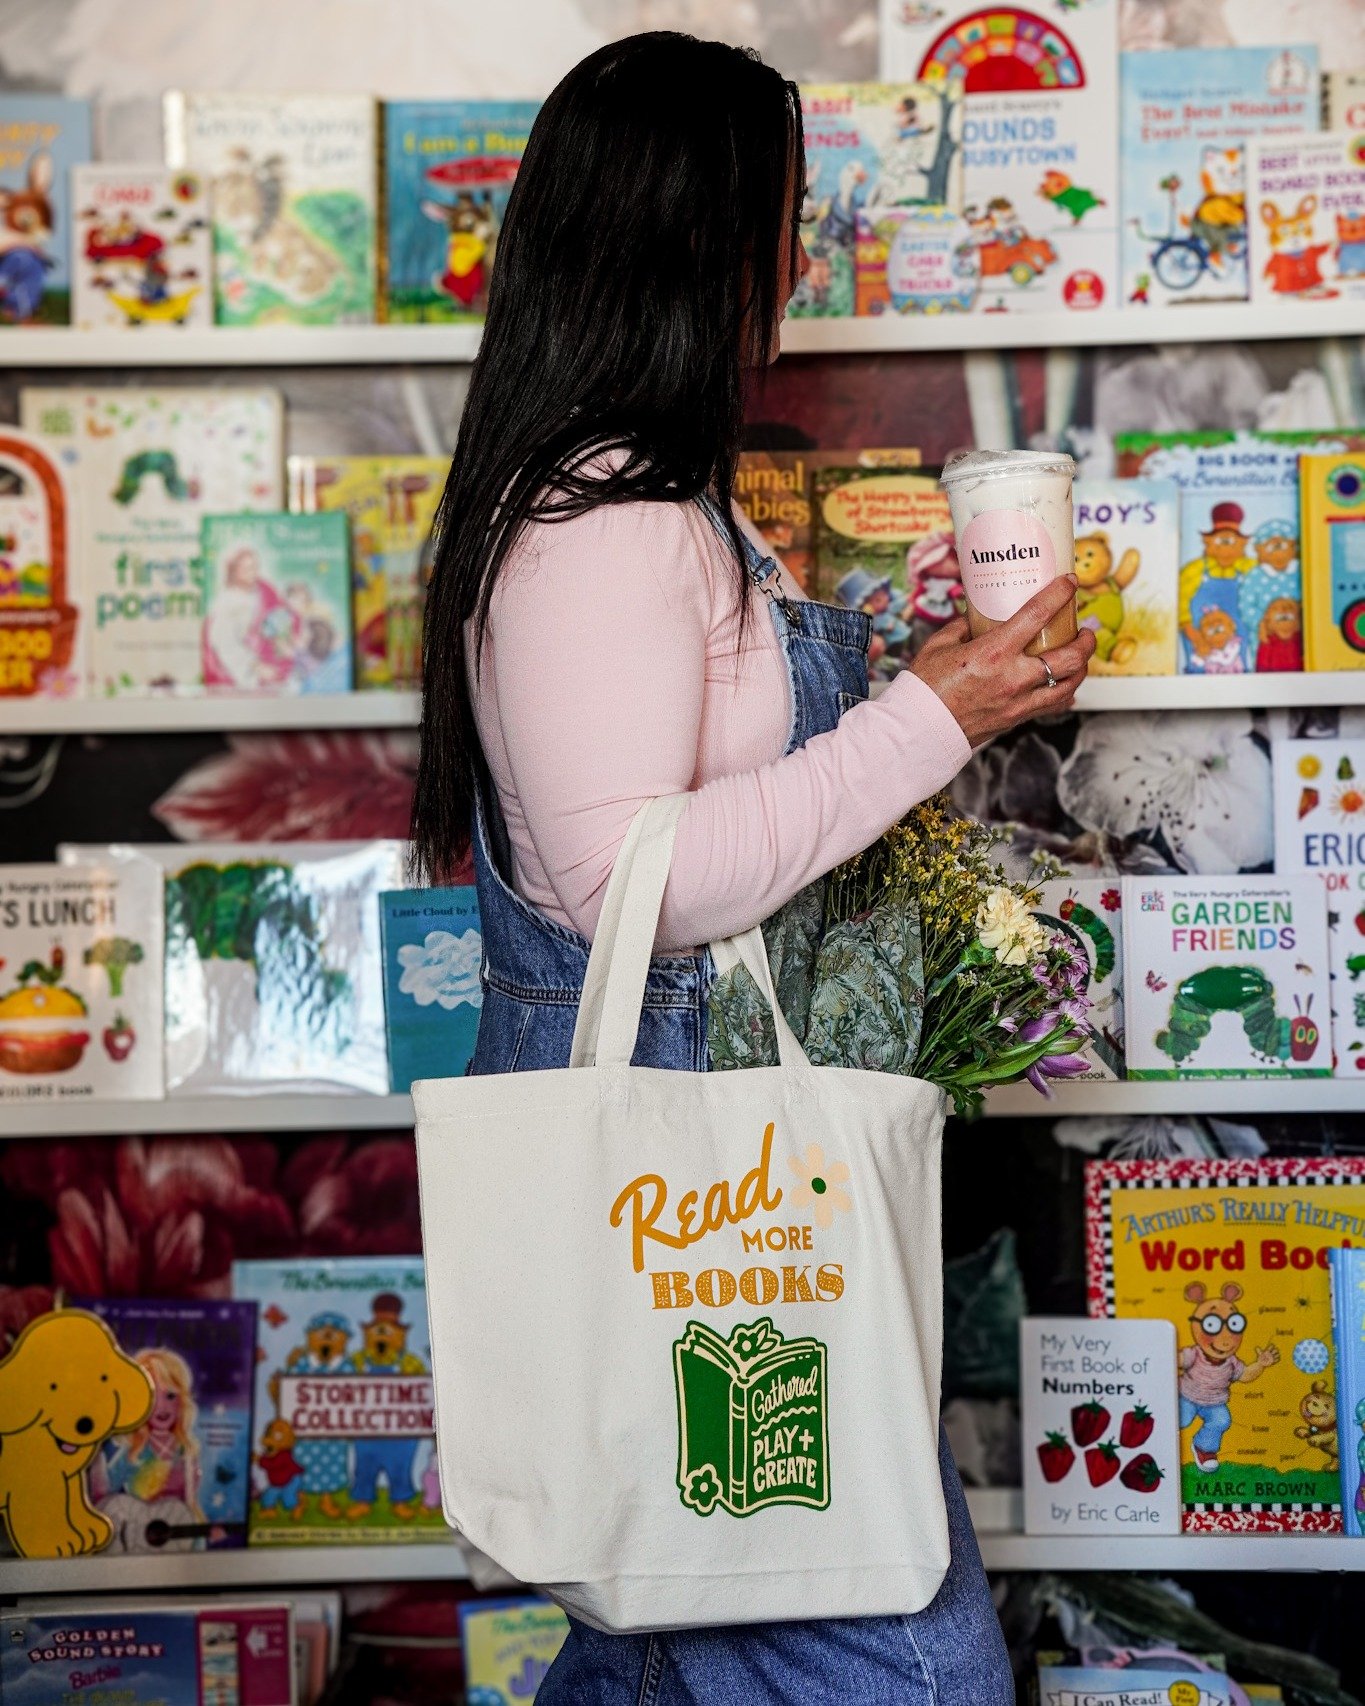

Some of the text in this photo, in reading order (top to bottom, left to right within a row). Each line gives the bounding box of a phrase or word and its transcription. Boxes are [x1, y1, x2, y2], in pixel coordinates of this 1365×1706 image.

[969, 543, 1040, 564] Amsden
[974, 578, 1038, 589] COFFEE CLUB
[28, 898, 115, 927] LUNCH
[392, 907, 420, 918] Little
[422, 907, 453, 917] Cloud
[456, 906, 468, 917] by
[1171, 900, 1293, 926] GARDEN
[1172, 926, 1296, 952] FRIENDS
[609, 1122, 783, 1274] Read
[1121, 1197, 1365, 1243] ARTHUR'S REALLY HELPFU
[740, 1226, 813, 1253] MORE
[1140, 1239, 1245, 1271] Word
[648, 1263, 844, 1310] BOOKS
[1041, 1334, 1112, 1356] My Very
[1041, 1355, 1150, 1375] First Book of
[296, 1381, 430, 1405] STORYTIME
[751, 1366, 818, 1423] Gathered
[1042, 1377, 1135, 1396] Numbers
[292, 1408, 434, 1431] COLLECTION
[753, 1456, 816, 1489] CREATE
[1195, 1481, 1317, 1497] MARC BROWN
[1051, 1505, 1160, 1524] by Eric Carle
[53, 1628, 136, 1644] GOLDEN
[28, 1644, 163, 1663] SOUND STORY
[69, 1666, 122, 1691] Barbie
[1119, 1692, 1162, 1706] Read!
